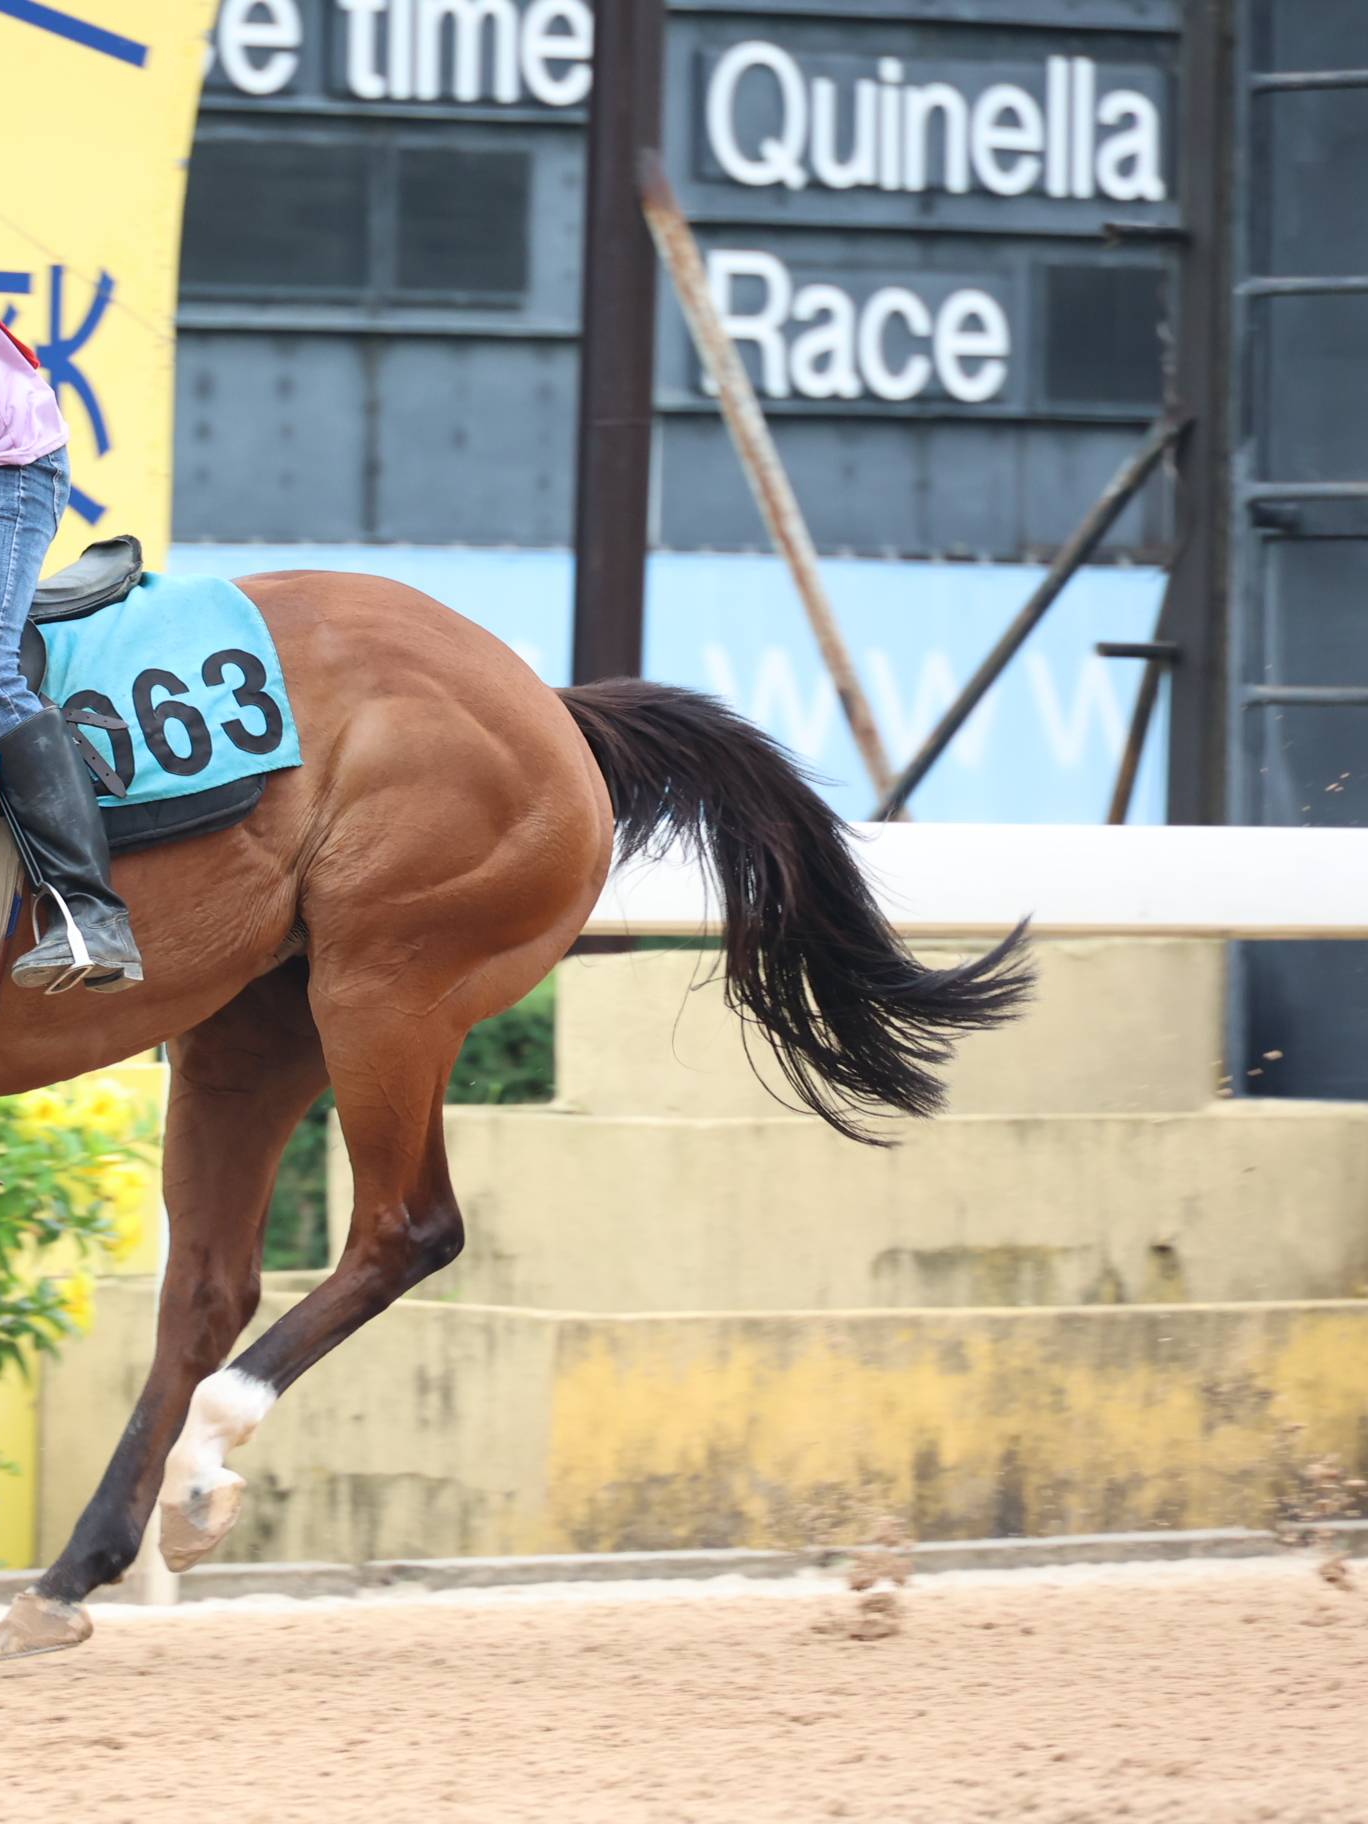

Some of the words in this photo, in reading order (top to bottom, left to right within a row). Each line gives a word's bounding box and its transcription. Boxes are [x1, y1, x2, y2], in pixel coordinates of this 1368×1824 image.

[197, 0, 303, 96] e
[341, 0, 595, 107] time
[705, 40, 1167, 202] Quinella
[702, 248, 1011, 403] Race
